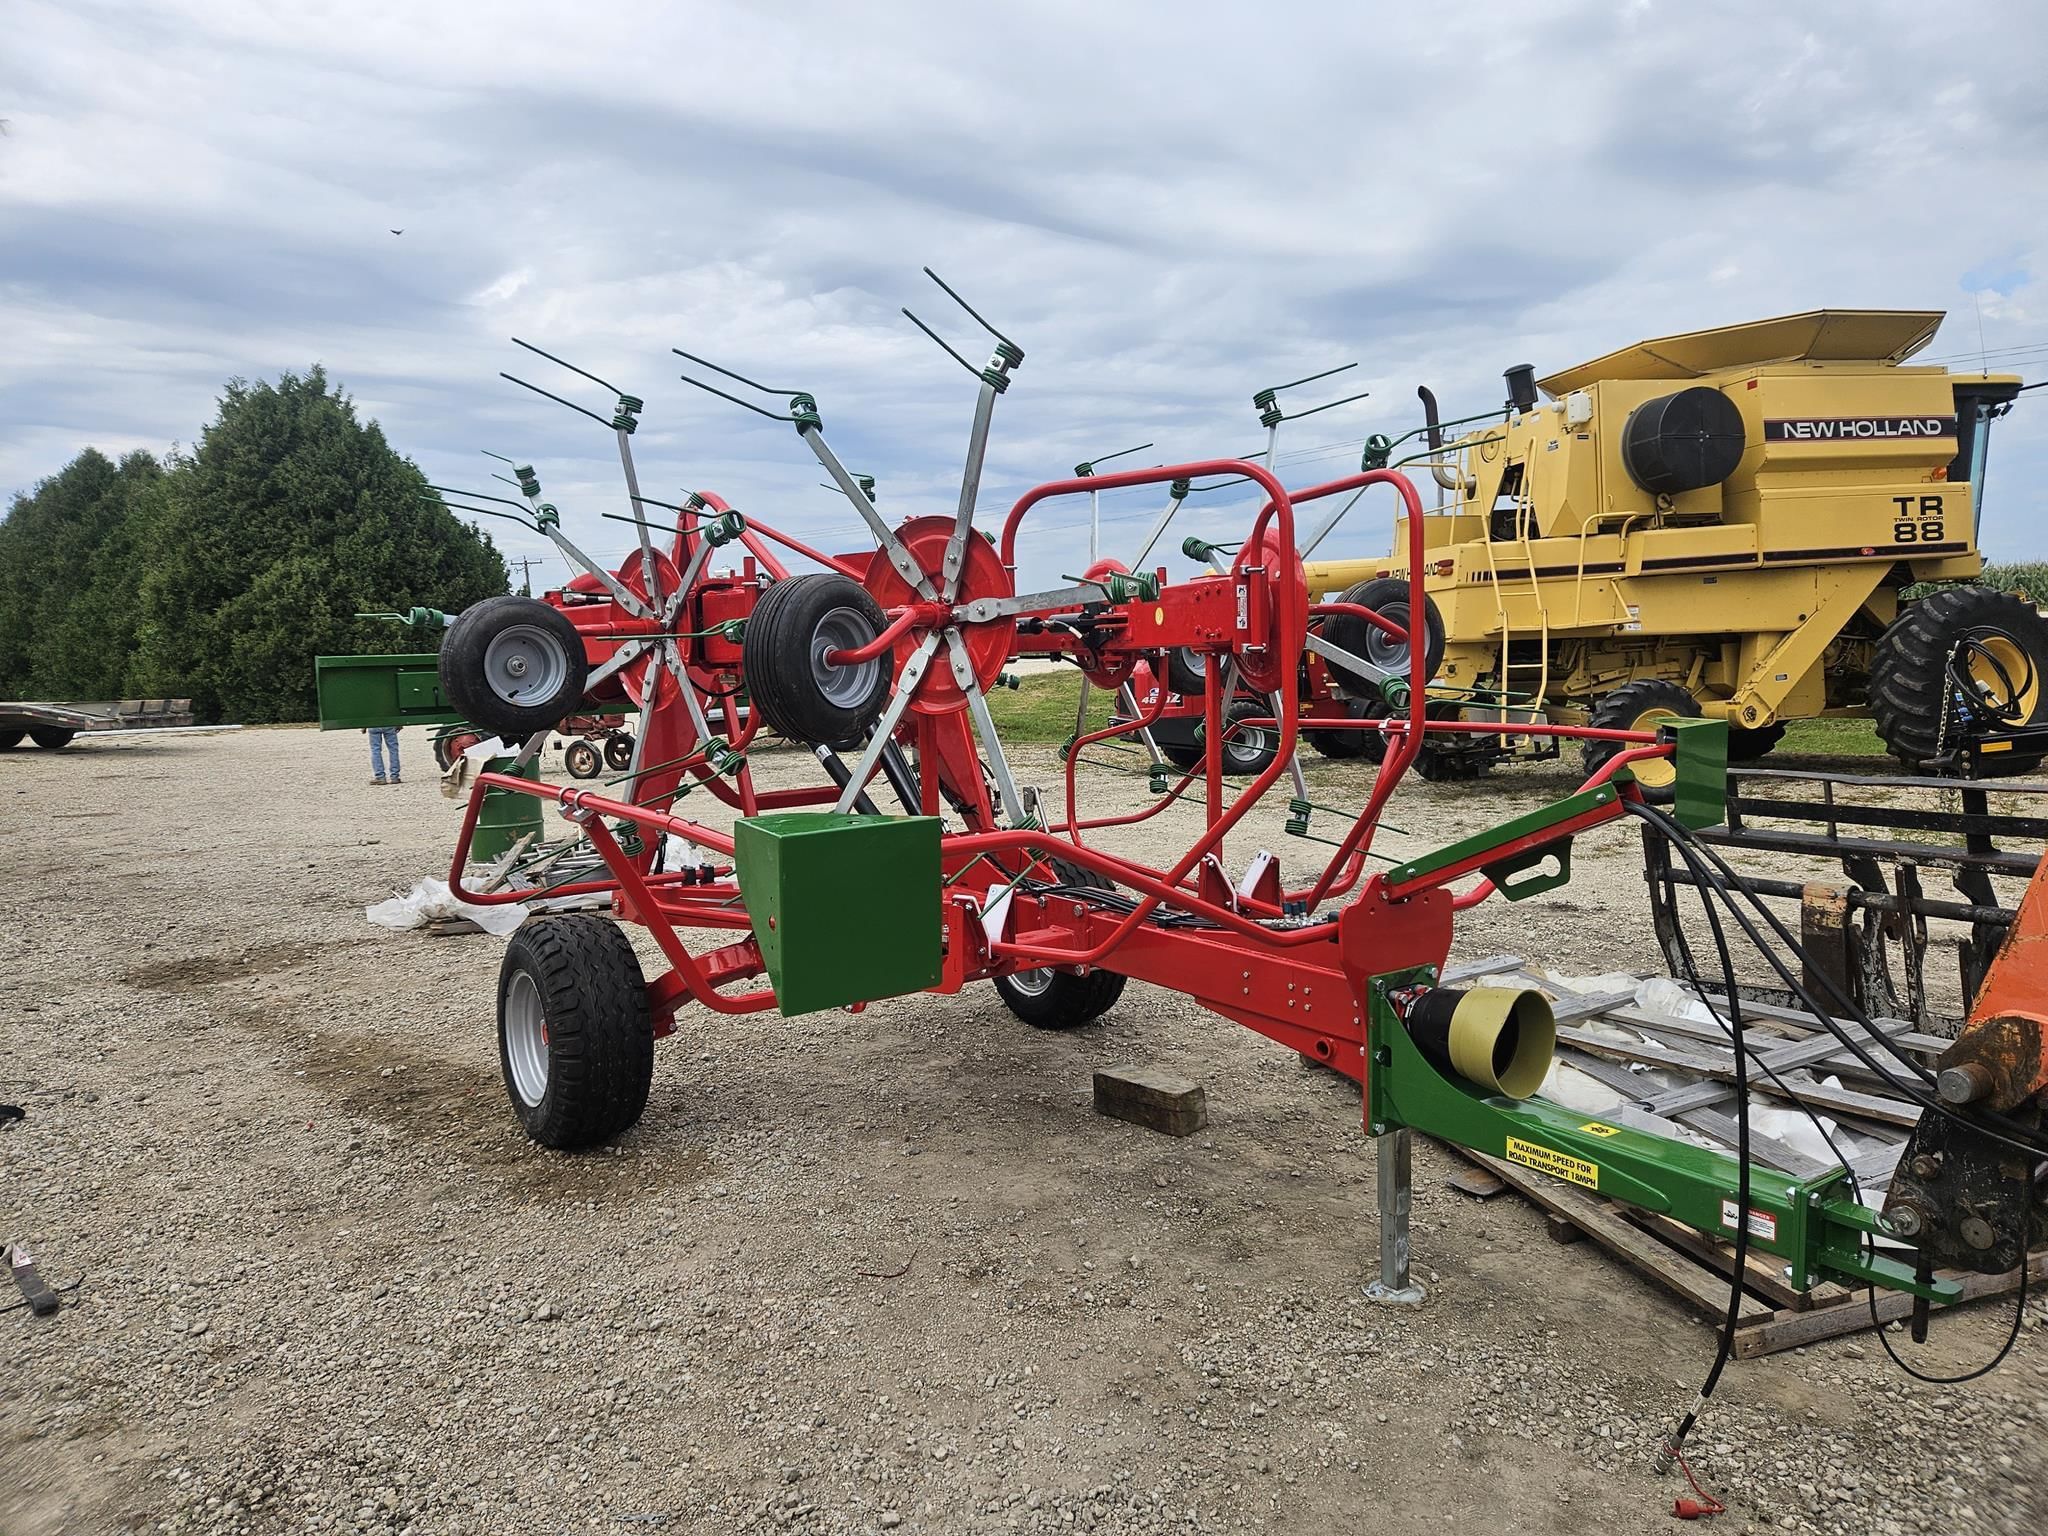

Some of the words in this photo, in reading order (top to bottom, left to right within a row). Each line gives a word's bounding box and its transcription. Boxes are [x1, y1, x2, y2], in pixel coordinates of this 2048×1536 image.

[1783, 422, 1834, 438] NEW
[1840, 420, 1942, 437] HOLLAND
[1893, 496, 1943, 516] TR
[1894, 522, 1945, 542] 88
[1407, 562, 1440, 580] HAND
[1513, 1142, 1551, 1160] MAXIMUM
[1552, 1155, 1575, 1169] SPEED
[1576, 1163, 1592, 1174] FOR
[1508, 1151, 1528, 1163] ROAD
[1529, 1158, 1569, 1178] TRANSPORT
[1571, 1172, 1596, 1187] 18MPH
